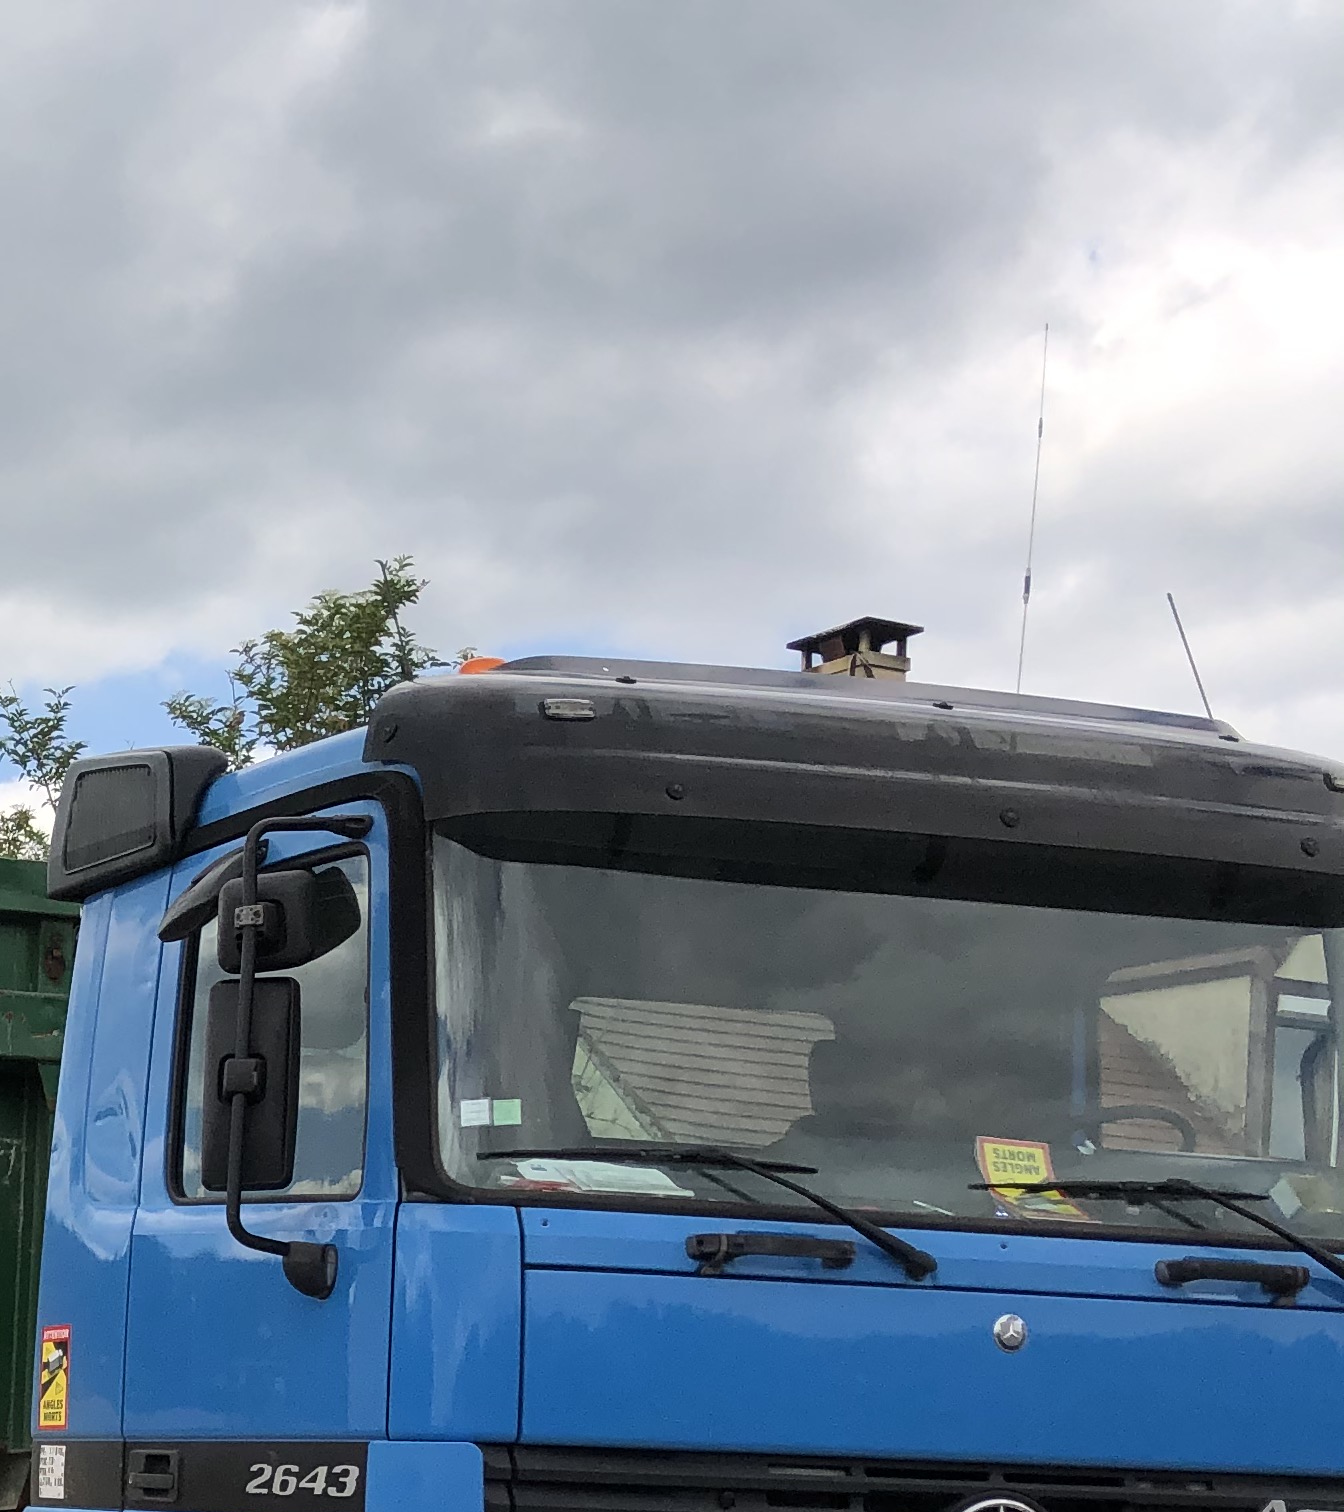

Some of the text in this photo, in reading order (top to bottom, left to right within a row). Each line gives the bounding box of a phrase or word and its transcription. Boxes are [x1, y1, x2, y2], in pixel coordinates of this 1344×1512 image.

[993, 1148, 1036, 1162] MORTS
[993, 1161, 1040, 1175] ANGLES
[43, 1399, 63, 1410] ANGLES
[245, 1463, 360, 1497] 2643
